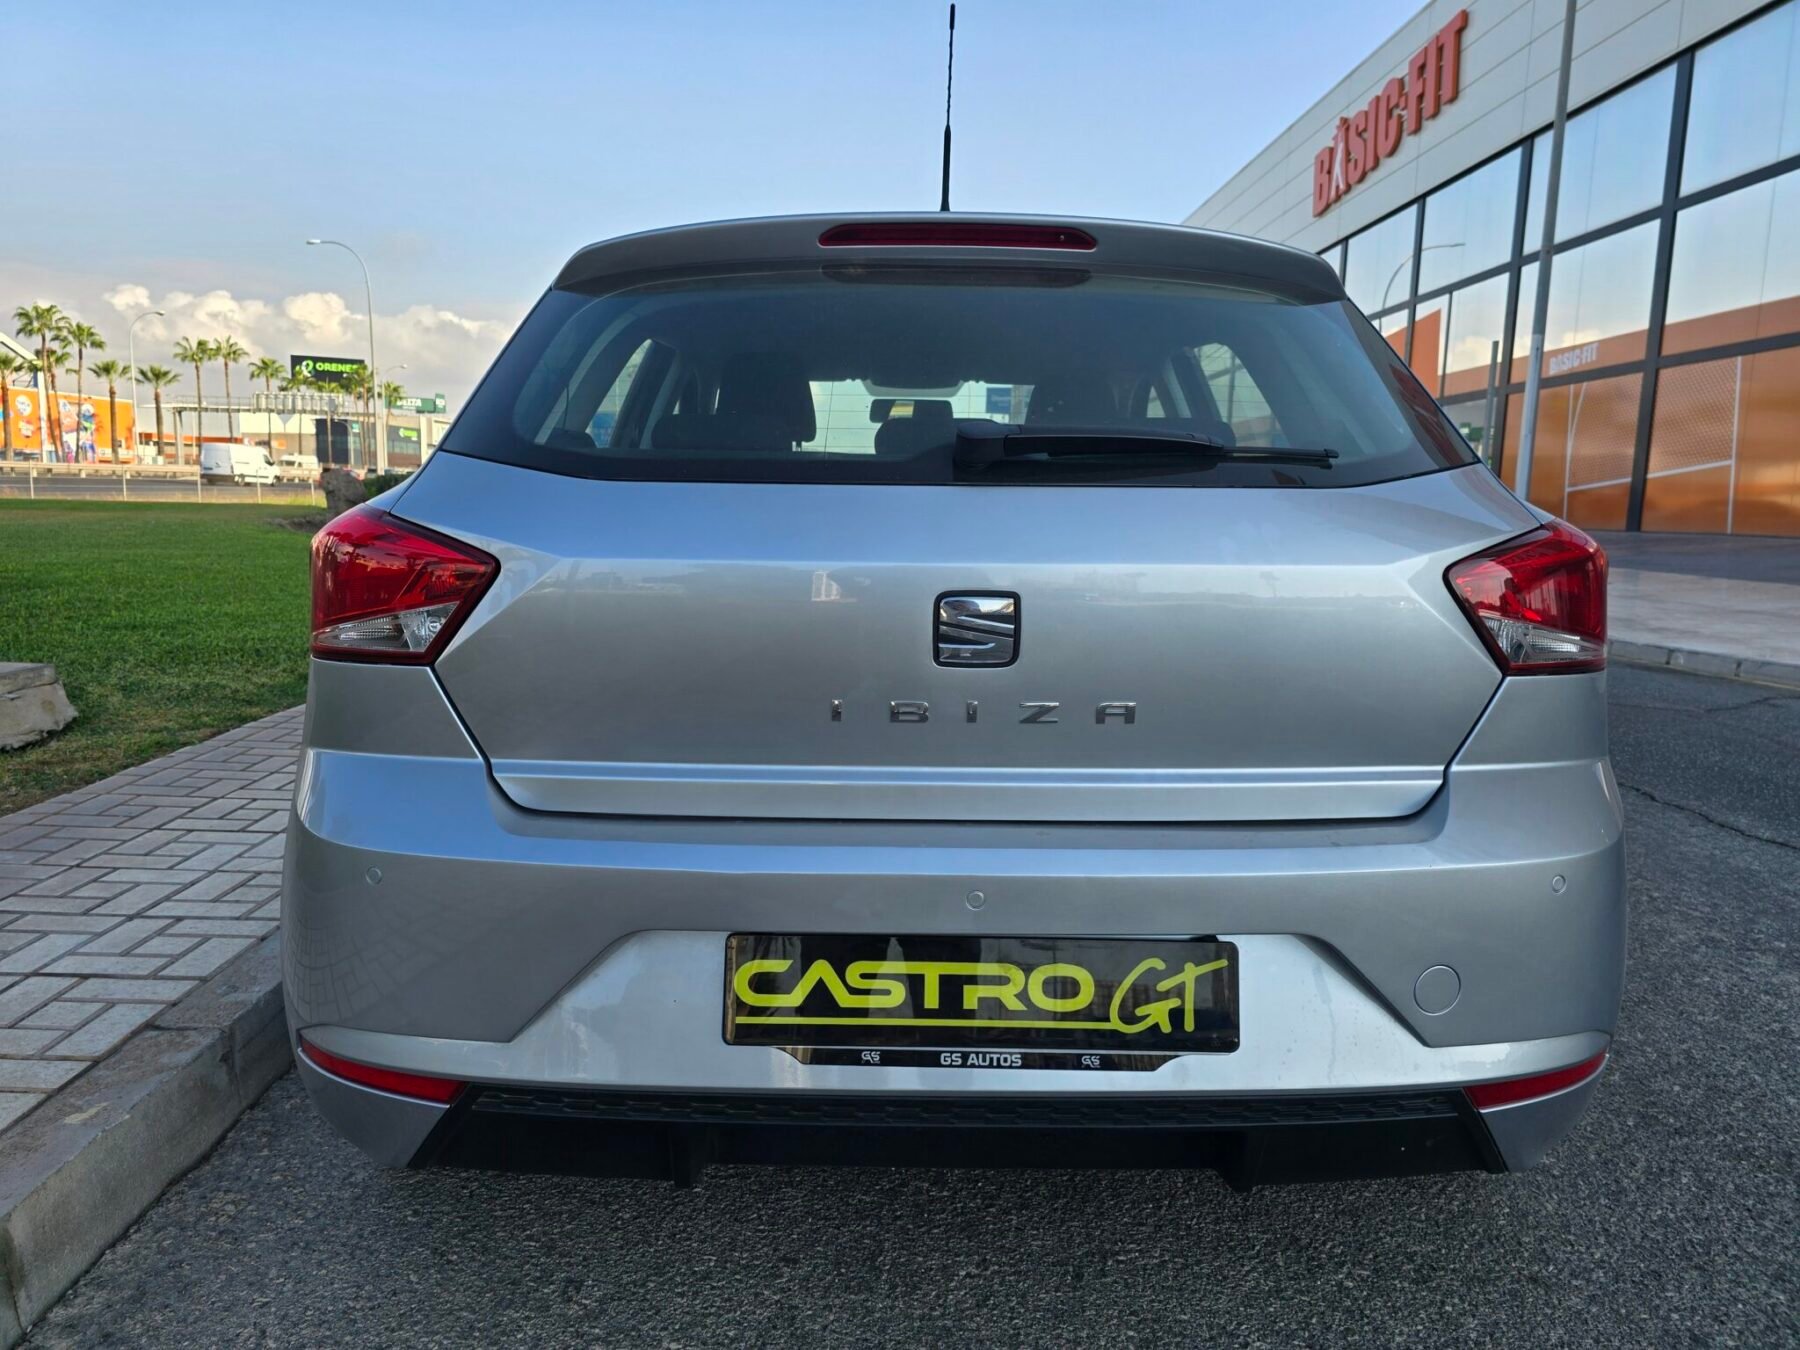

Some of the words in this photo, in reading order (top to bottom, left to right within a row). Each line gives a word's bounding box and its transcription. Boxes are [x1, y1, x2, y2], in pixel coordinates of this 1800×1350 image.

[1312, 9, 1469, 218] BASIC-FIT
[831, 700, 1137, 725] IBIZA
[733, 958, 1096, 1013] CASTRO
[1109, 957, 1229, 1034] GT
[940, 1052, 962, 1066] GS
[967, 1053, 1022, 1067] AUTOS
